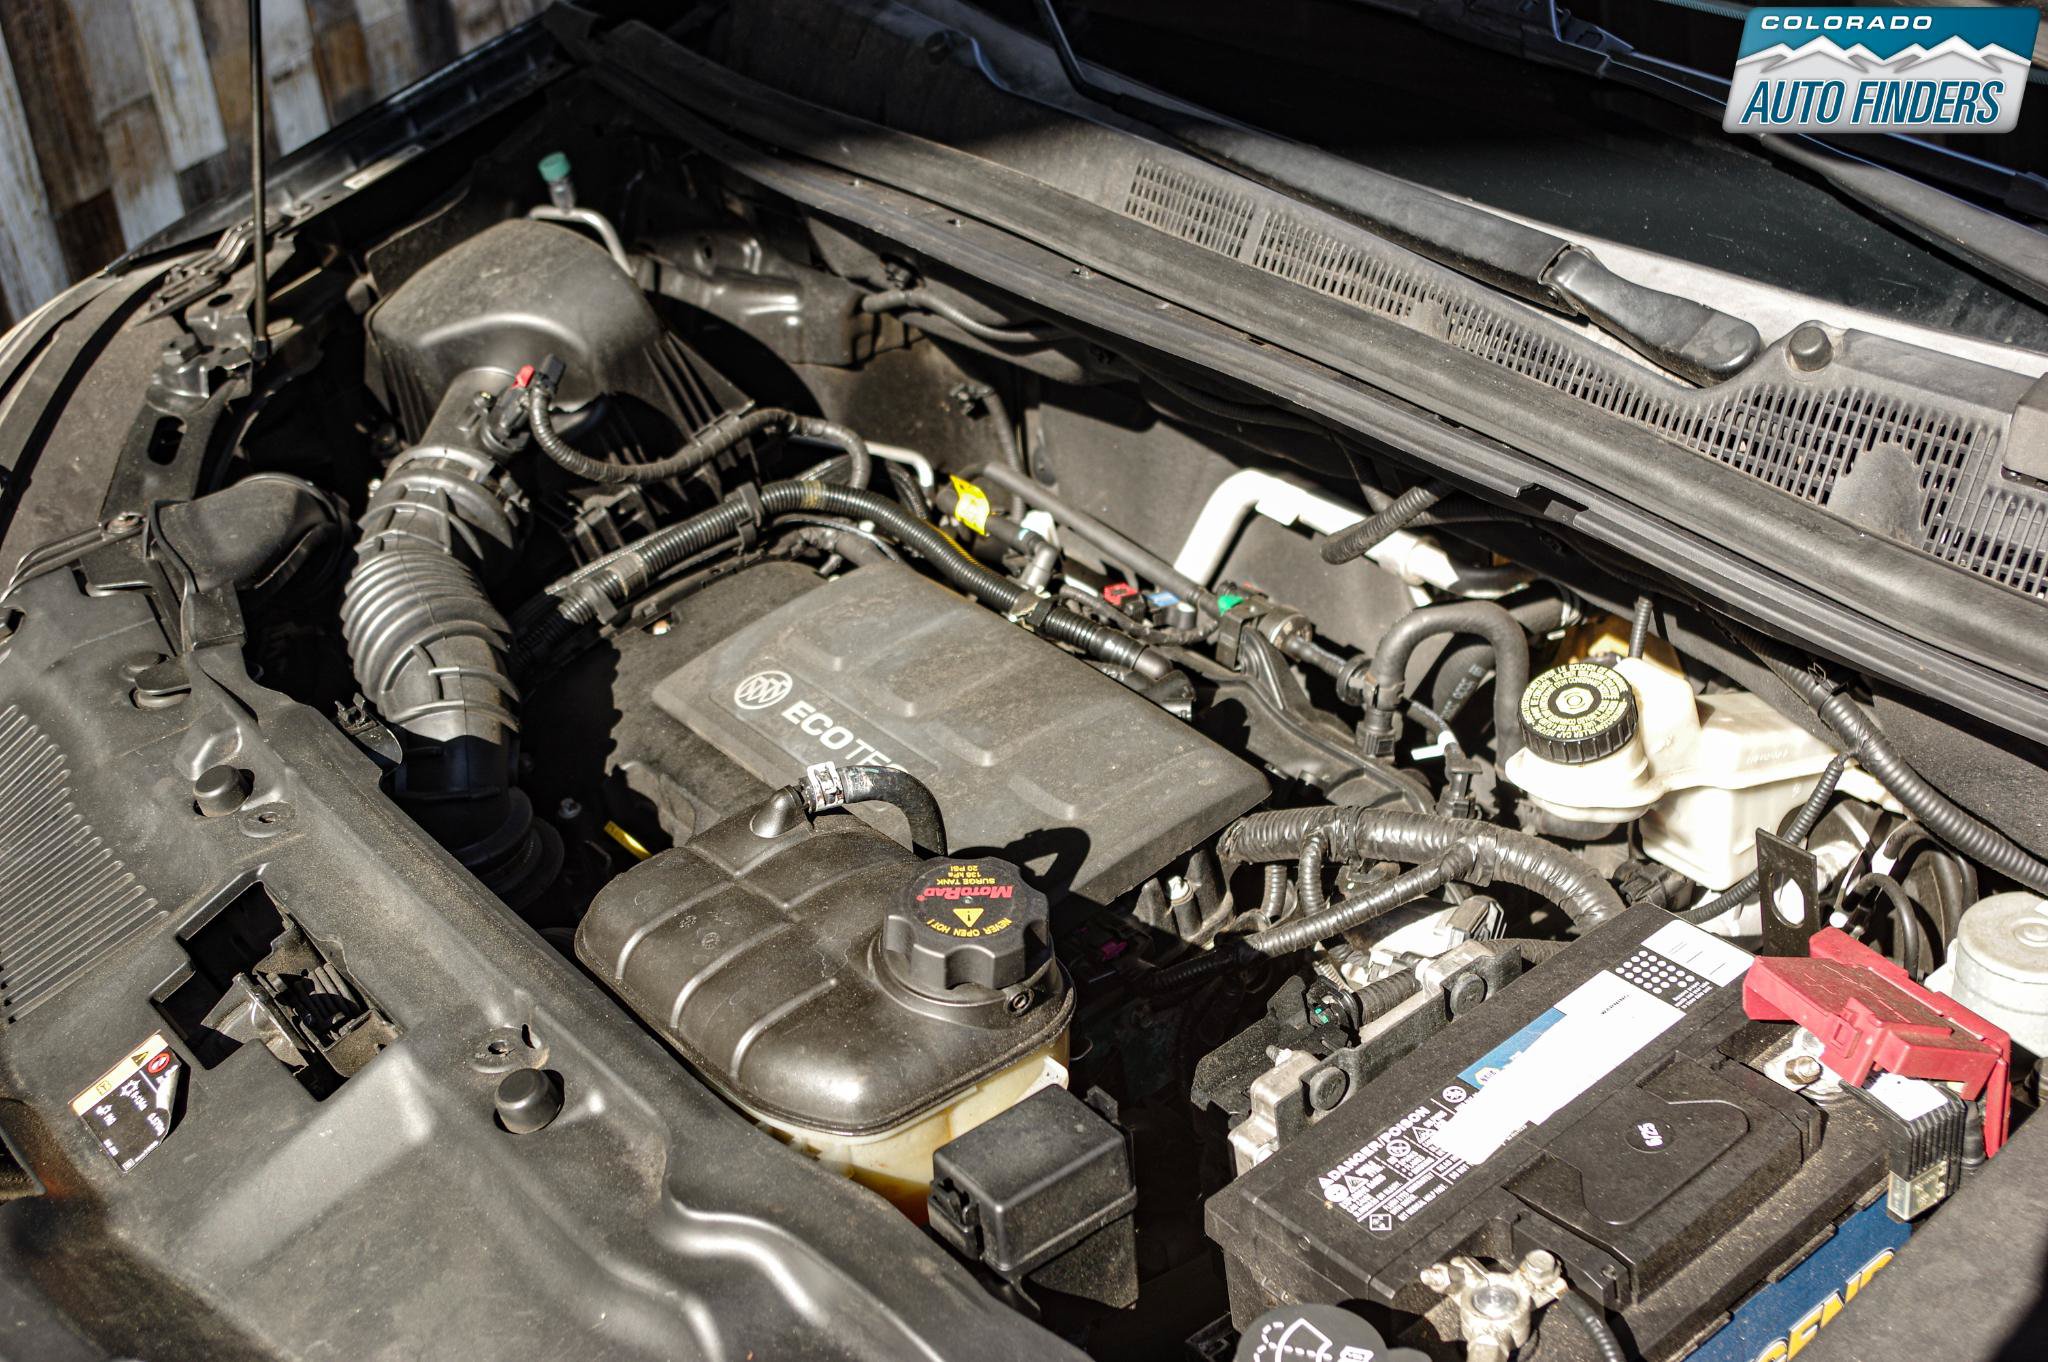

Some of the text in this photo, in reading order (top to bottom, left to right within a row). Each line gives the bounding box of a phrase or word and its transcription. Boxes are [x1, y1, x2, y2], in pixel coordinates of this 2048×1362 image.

[936, 878, 961, 886] TANK
[982, 917, 1013, 935] NEVER
[953, 928, 981, 937] OPEN
